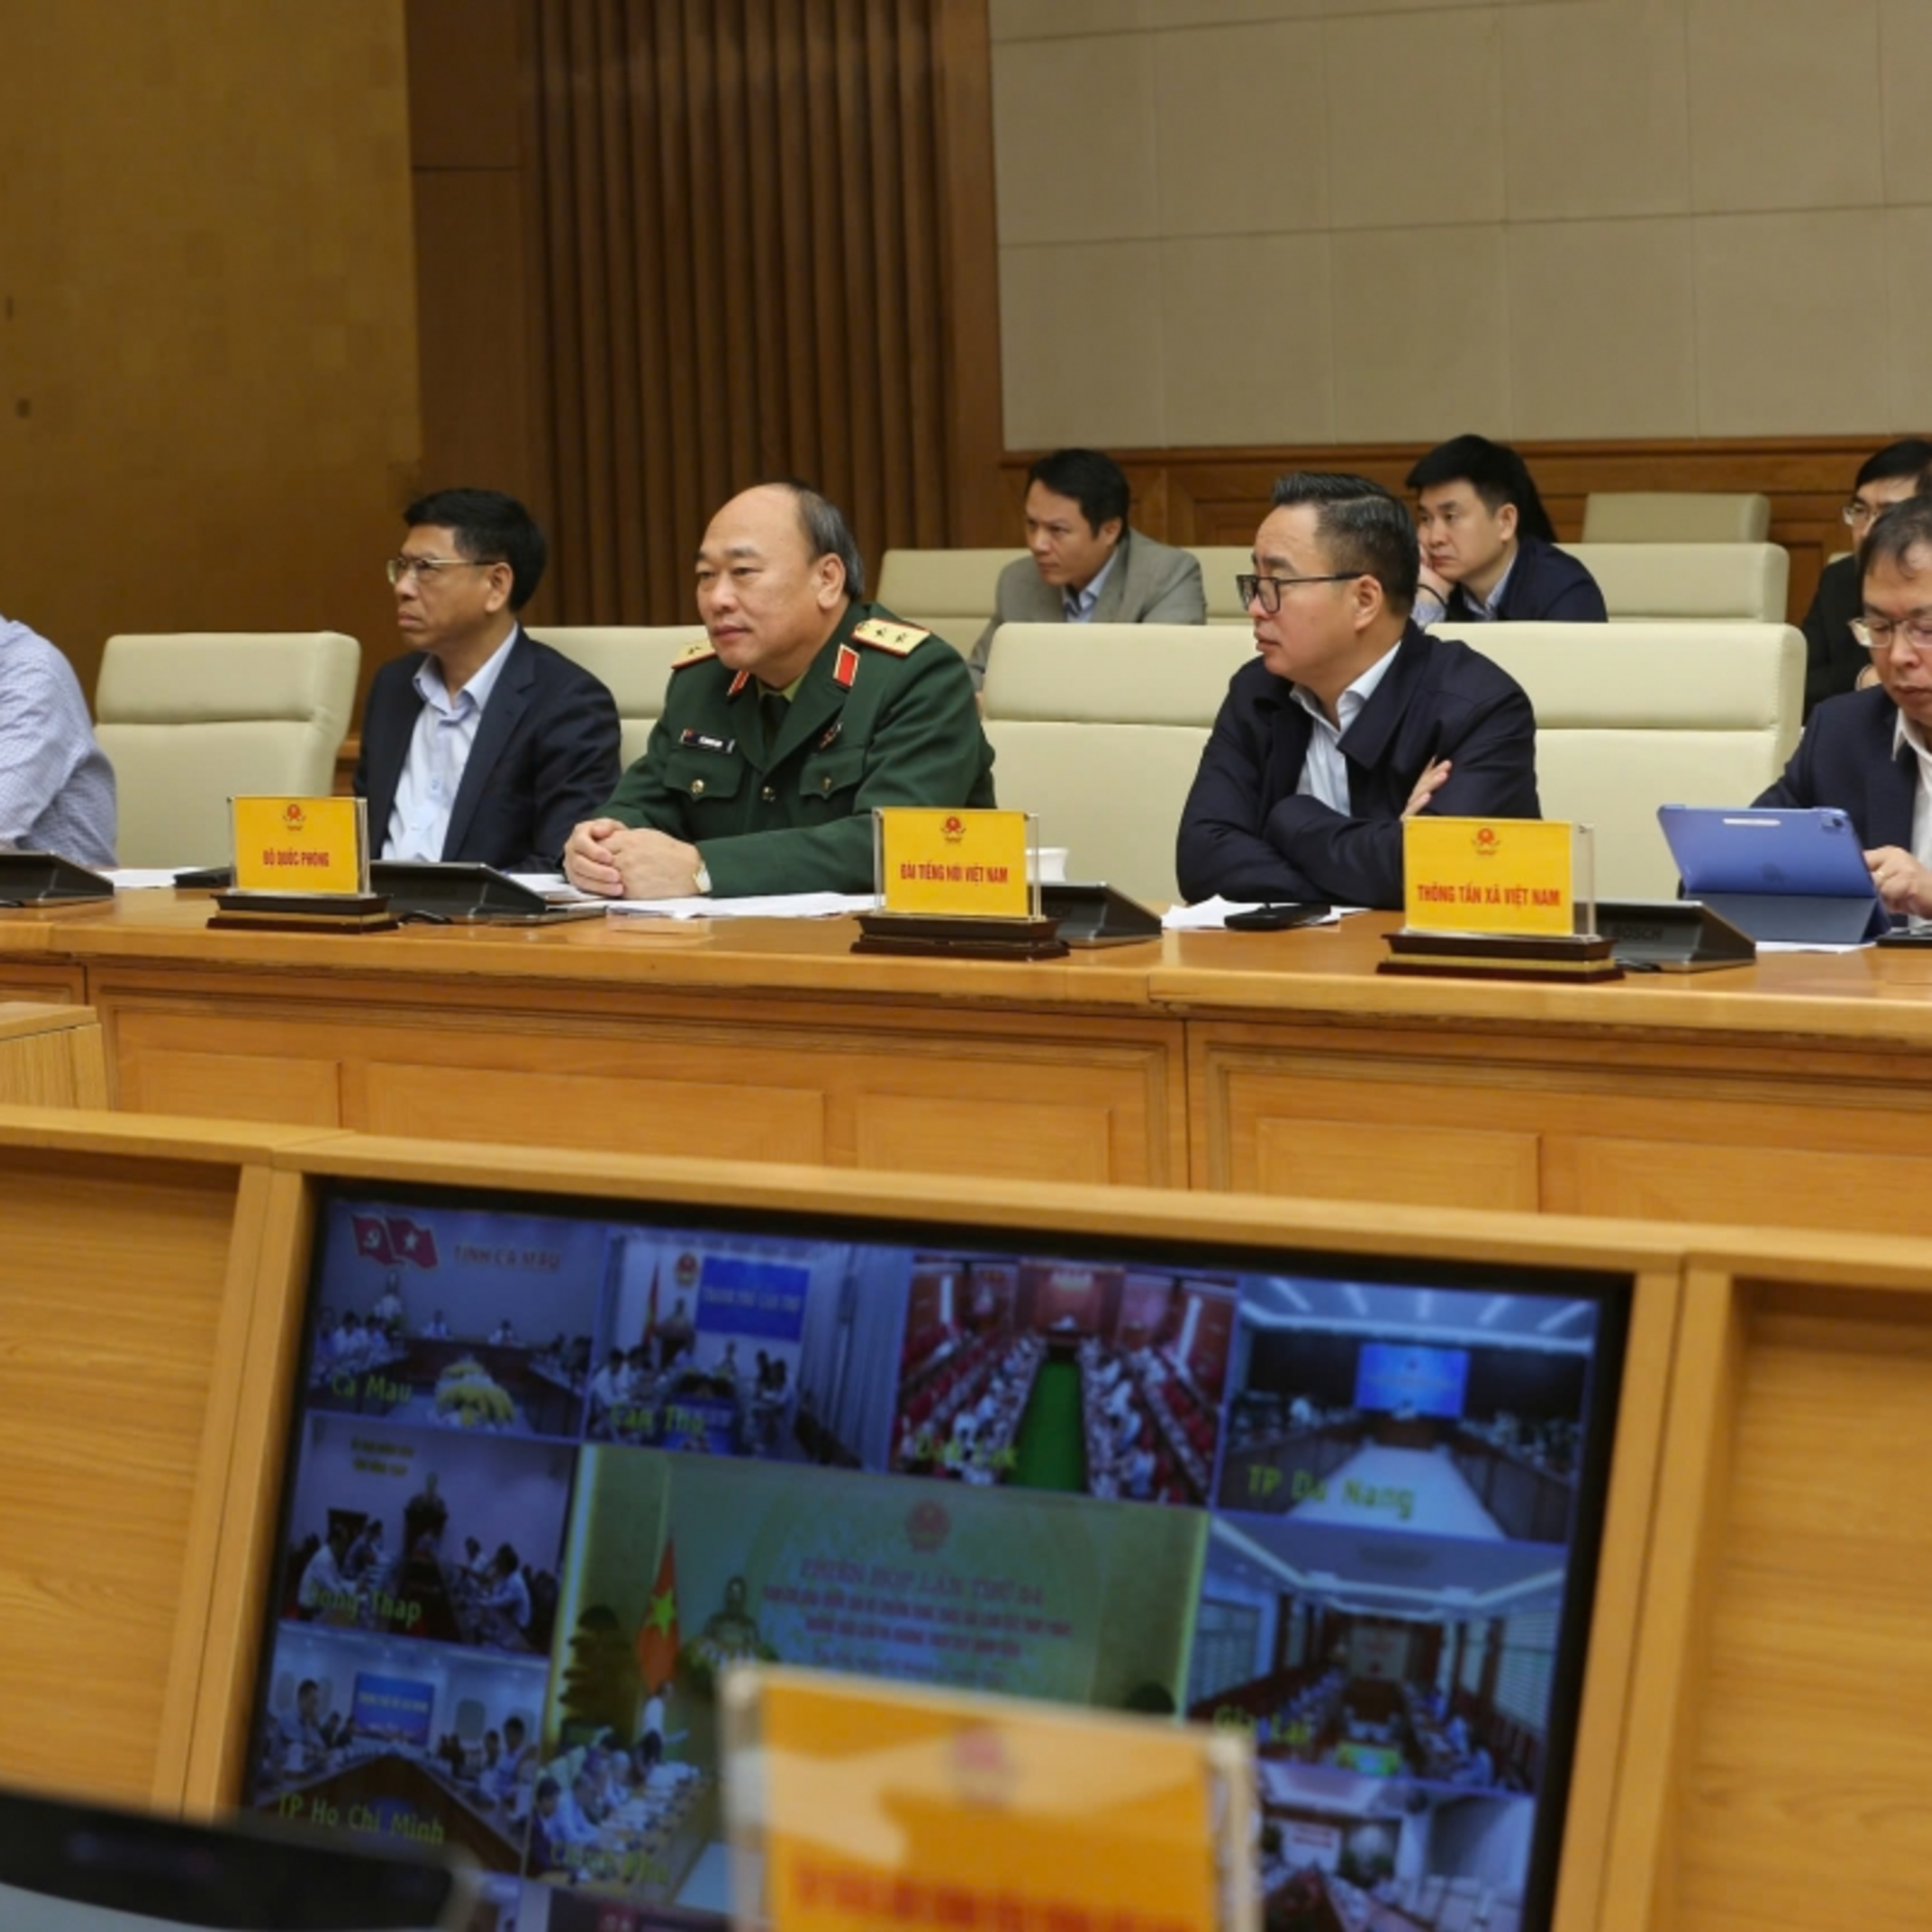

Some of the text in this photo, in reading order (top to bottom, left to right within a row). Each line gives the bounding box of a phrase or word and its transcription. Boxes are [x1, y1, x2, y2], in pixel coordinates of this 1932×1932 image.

[965, 864, 983, 886] VIỆT
[986, 867, 1008, 883] NAM
[1417, 880, 1561, 909] THÔNG TẤN XÃ VIỆT NAM
[1611, 923, 1663, 941] BOSCH
[332, 1370, 412, 1402] Ca Mau
[1248, 1464, 1414, 1520] TP Da Nang
[369, 1588, 422, 1630] Thap
[278, 1791, 444, 1846] TP Ho Chi Minh
